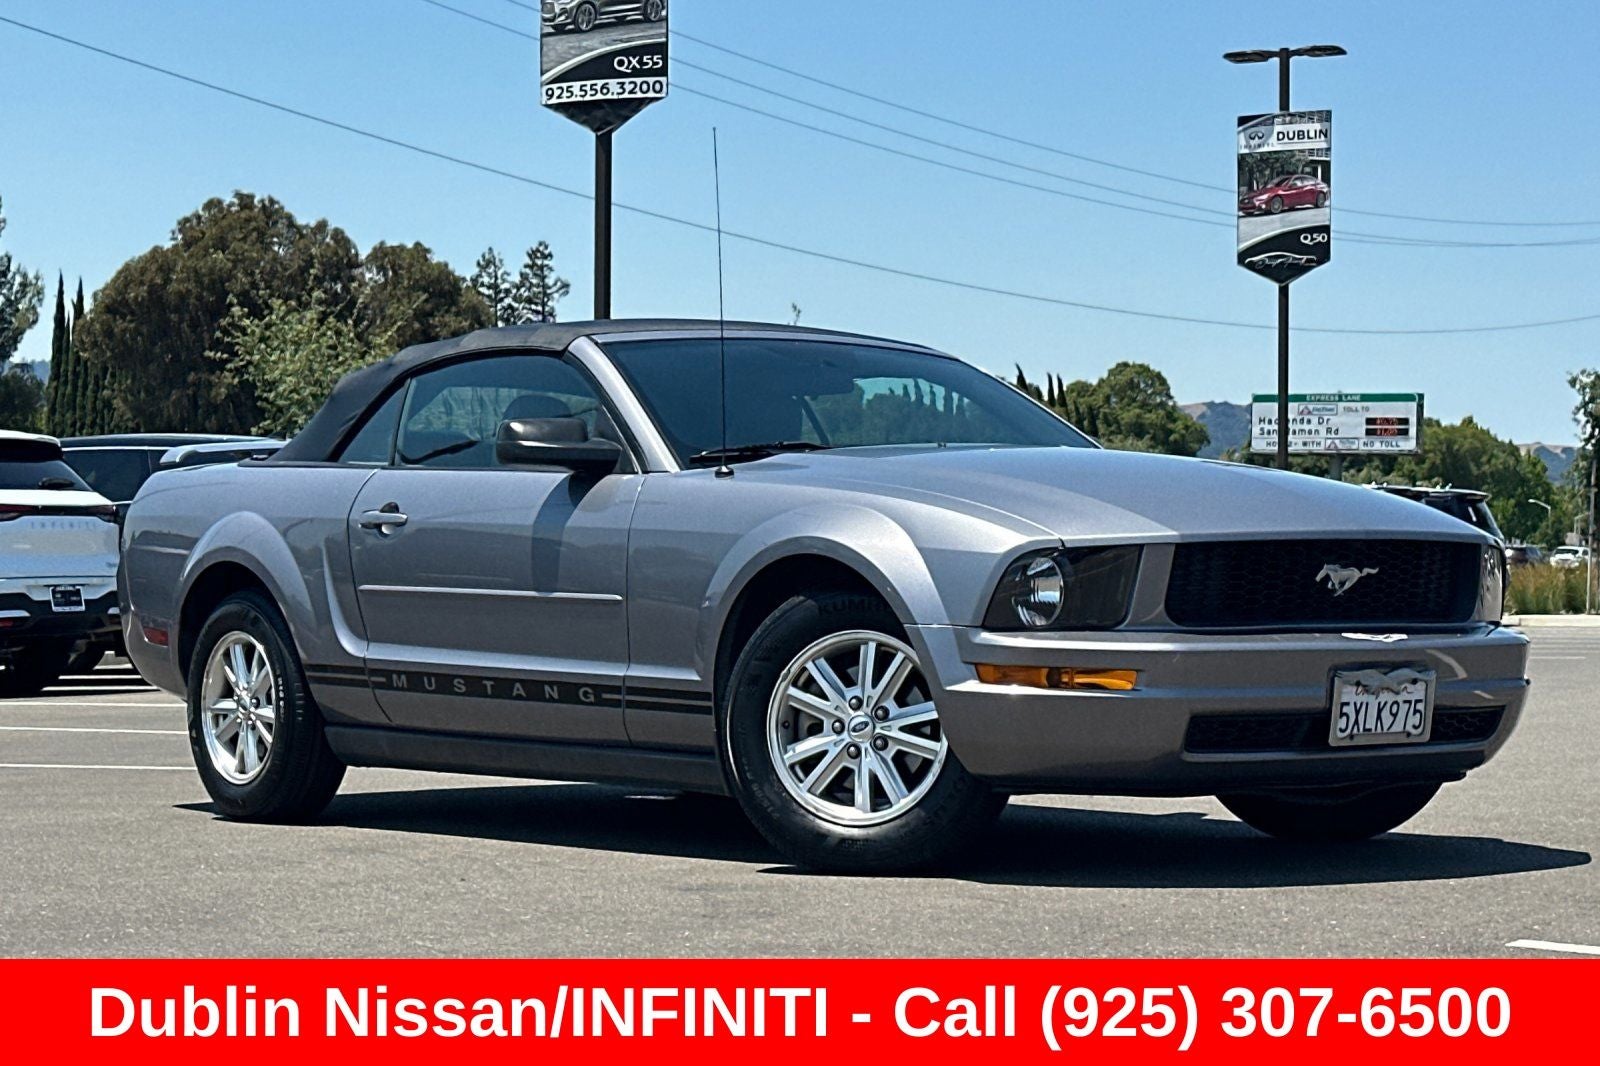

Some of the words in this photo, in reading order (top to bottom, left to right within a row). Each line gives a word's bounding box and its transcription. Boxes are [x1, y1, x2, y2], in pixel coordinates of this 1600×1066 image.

[613, 54, 663, 73] QX55
[545, 79, 664, 101] 925.556.3200
[1276, 128, 1329, 142] DUBLIN
[1300, 233, 1328, 245] Q50
[1318, 417, 1331, 425] Dr
[1259, 427, 1278, 435] San
[1288, 427, 1319, 435] amon
[1326, 427, 1339, 435] Rd
[392, 673, 606, 703] MUSTANG
[1338, 699, 1424, 734] 5XLK975
